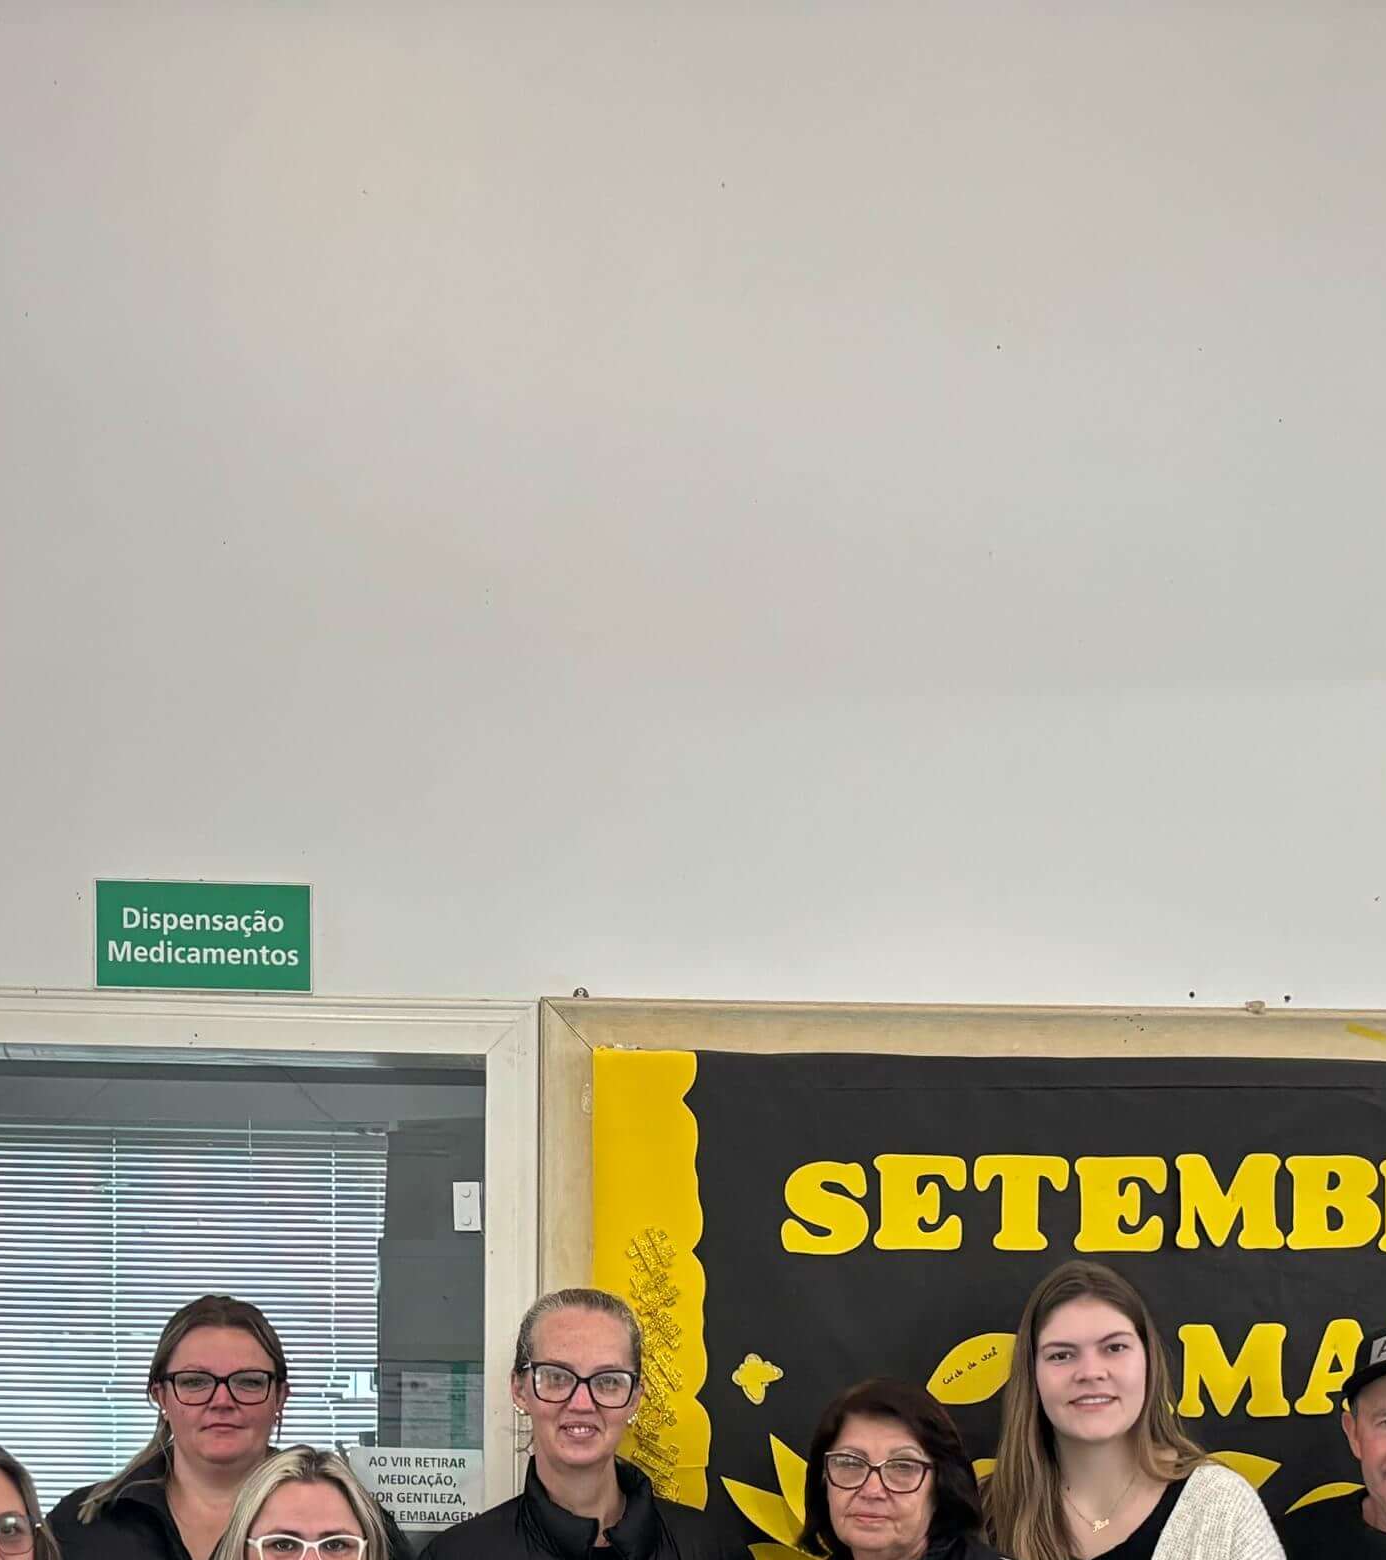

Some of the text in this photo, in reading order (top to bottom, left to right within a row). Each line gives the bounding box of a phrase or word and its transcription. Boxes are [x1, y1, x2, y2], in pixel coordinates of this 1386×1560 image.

[122, 906, 285, 938] Dispensação
[107, 940, 299, 967] Medicamentos
[368, 1456, 466, 1468] AO VIR RETIRAR
[378, 1473, 457, 1488] MEDICAÇÃO,
[397, 1492, 466, 1506] GENTILEZA,
